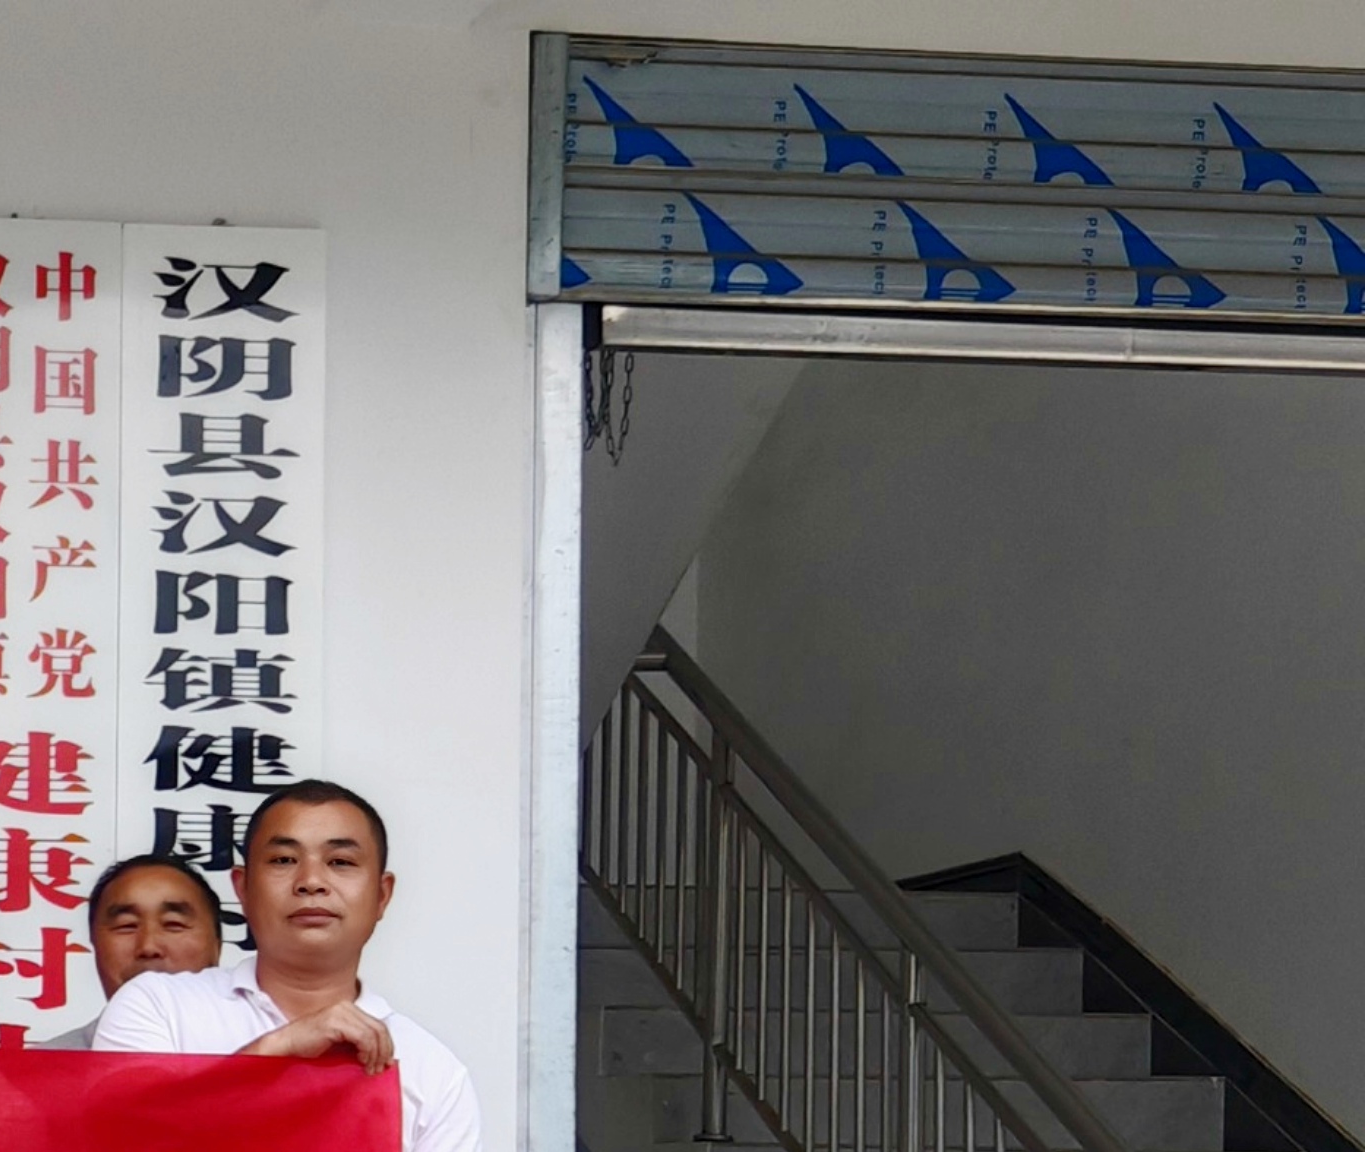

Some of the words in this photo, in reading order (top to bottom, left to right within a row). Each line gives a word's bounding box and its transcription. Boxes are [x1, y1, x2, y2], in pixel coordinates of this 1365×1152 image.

[28, 251, 98, 699] 中国共产党
